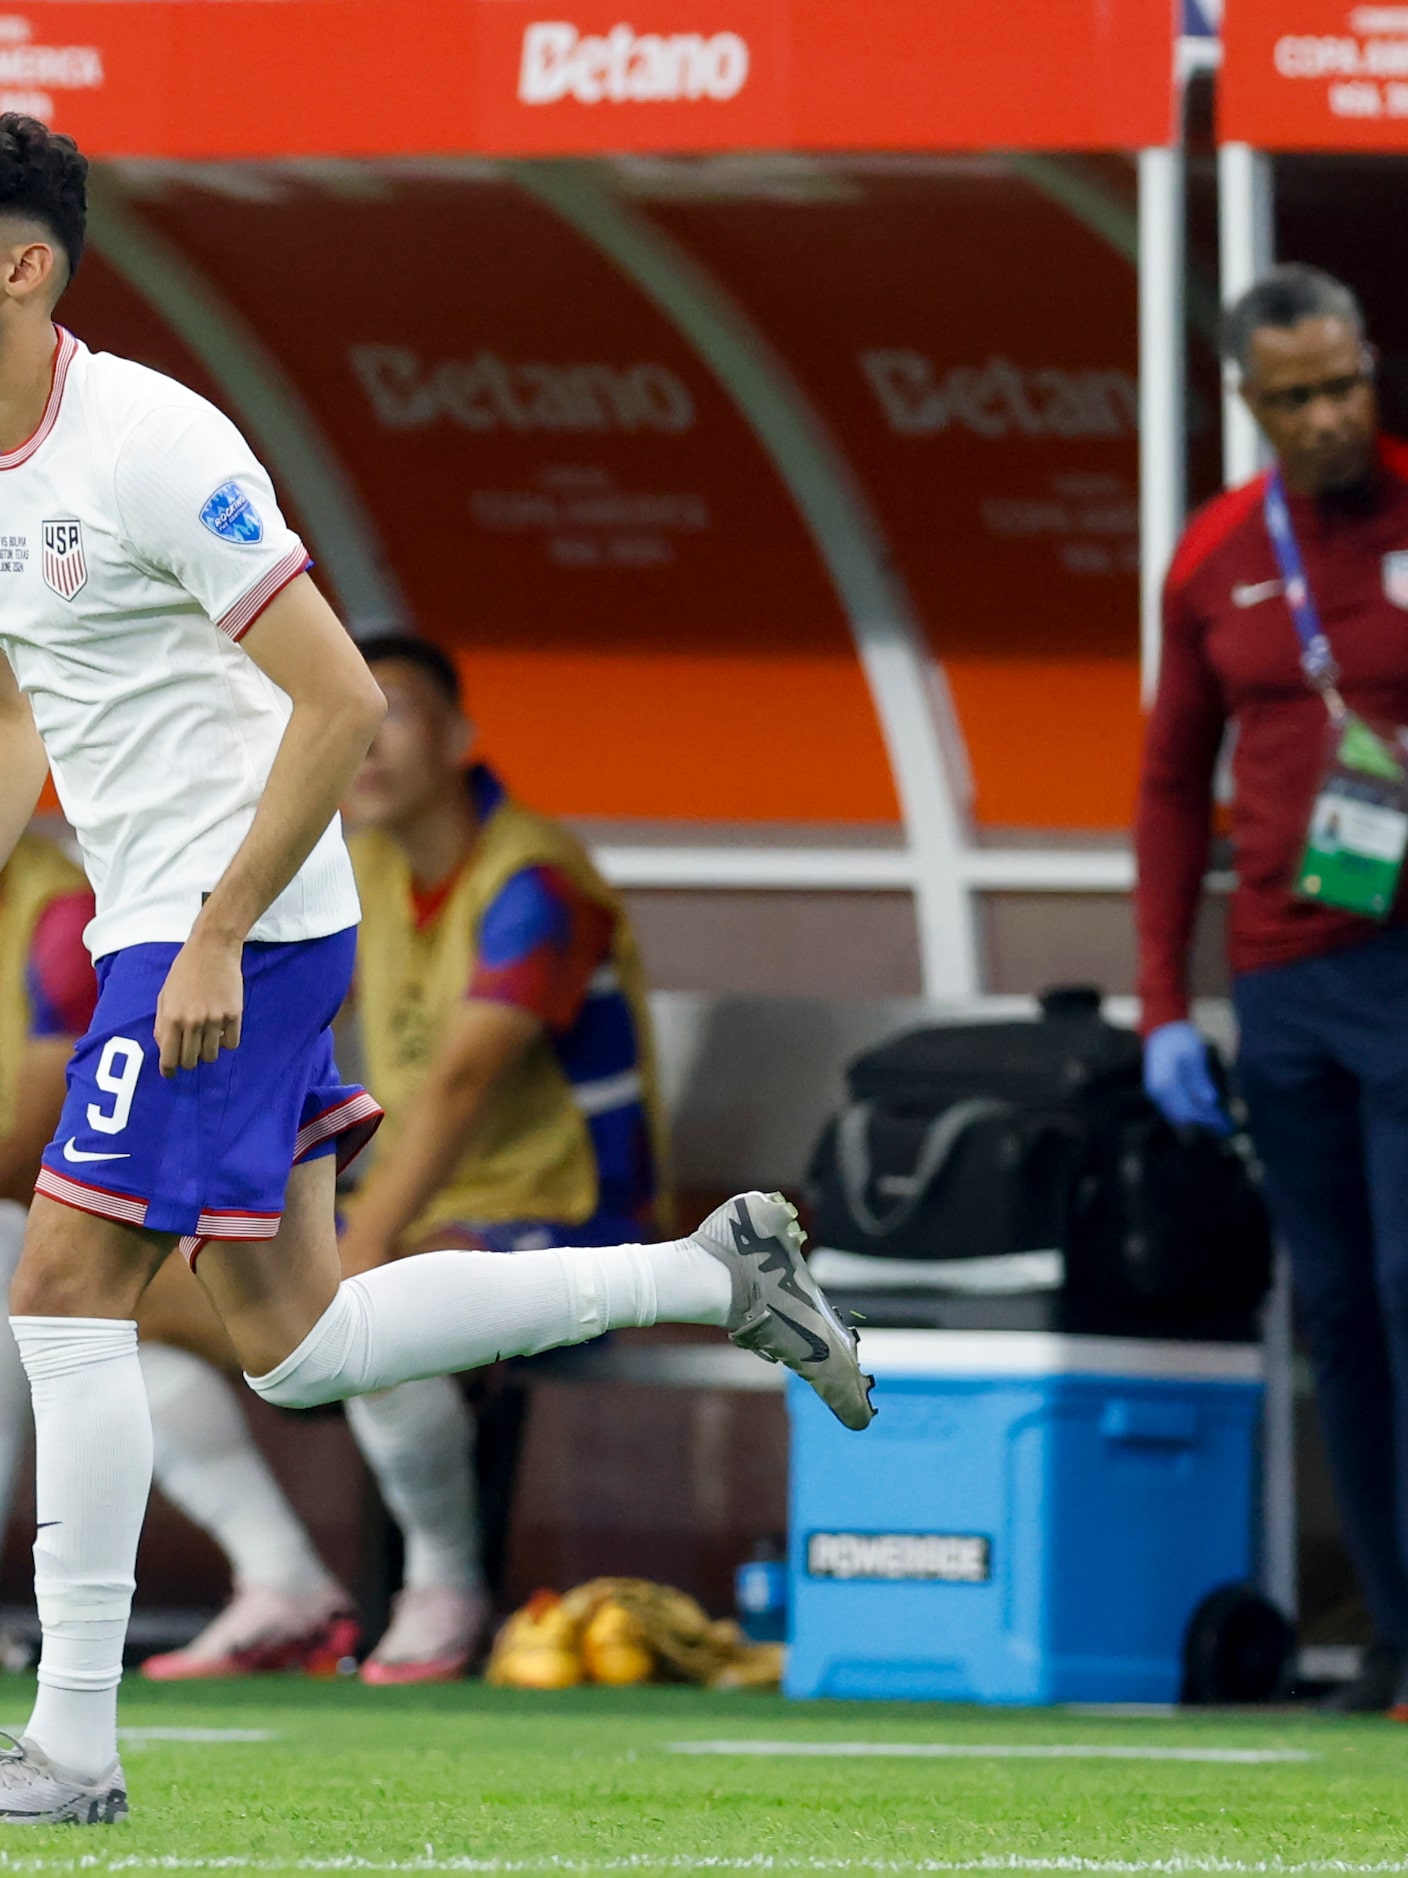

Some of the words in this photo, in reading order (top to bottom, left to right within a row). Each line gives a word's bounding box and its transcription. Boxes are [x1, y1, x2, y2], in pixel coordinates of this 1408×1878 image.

[517, 21, 749, 106] Betano
[347, 344, 697, 433] Betano
[860, 349, 1139, 437] Betan
[45, 526, 79, 555] USA
[86, 1036, 144, 1135] 9
